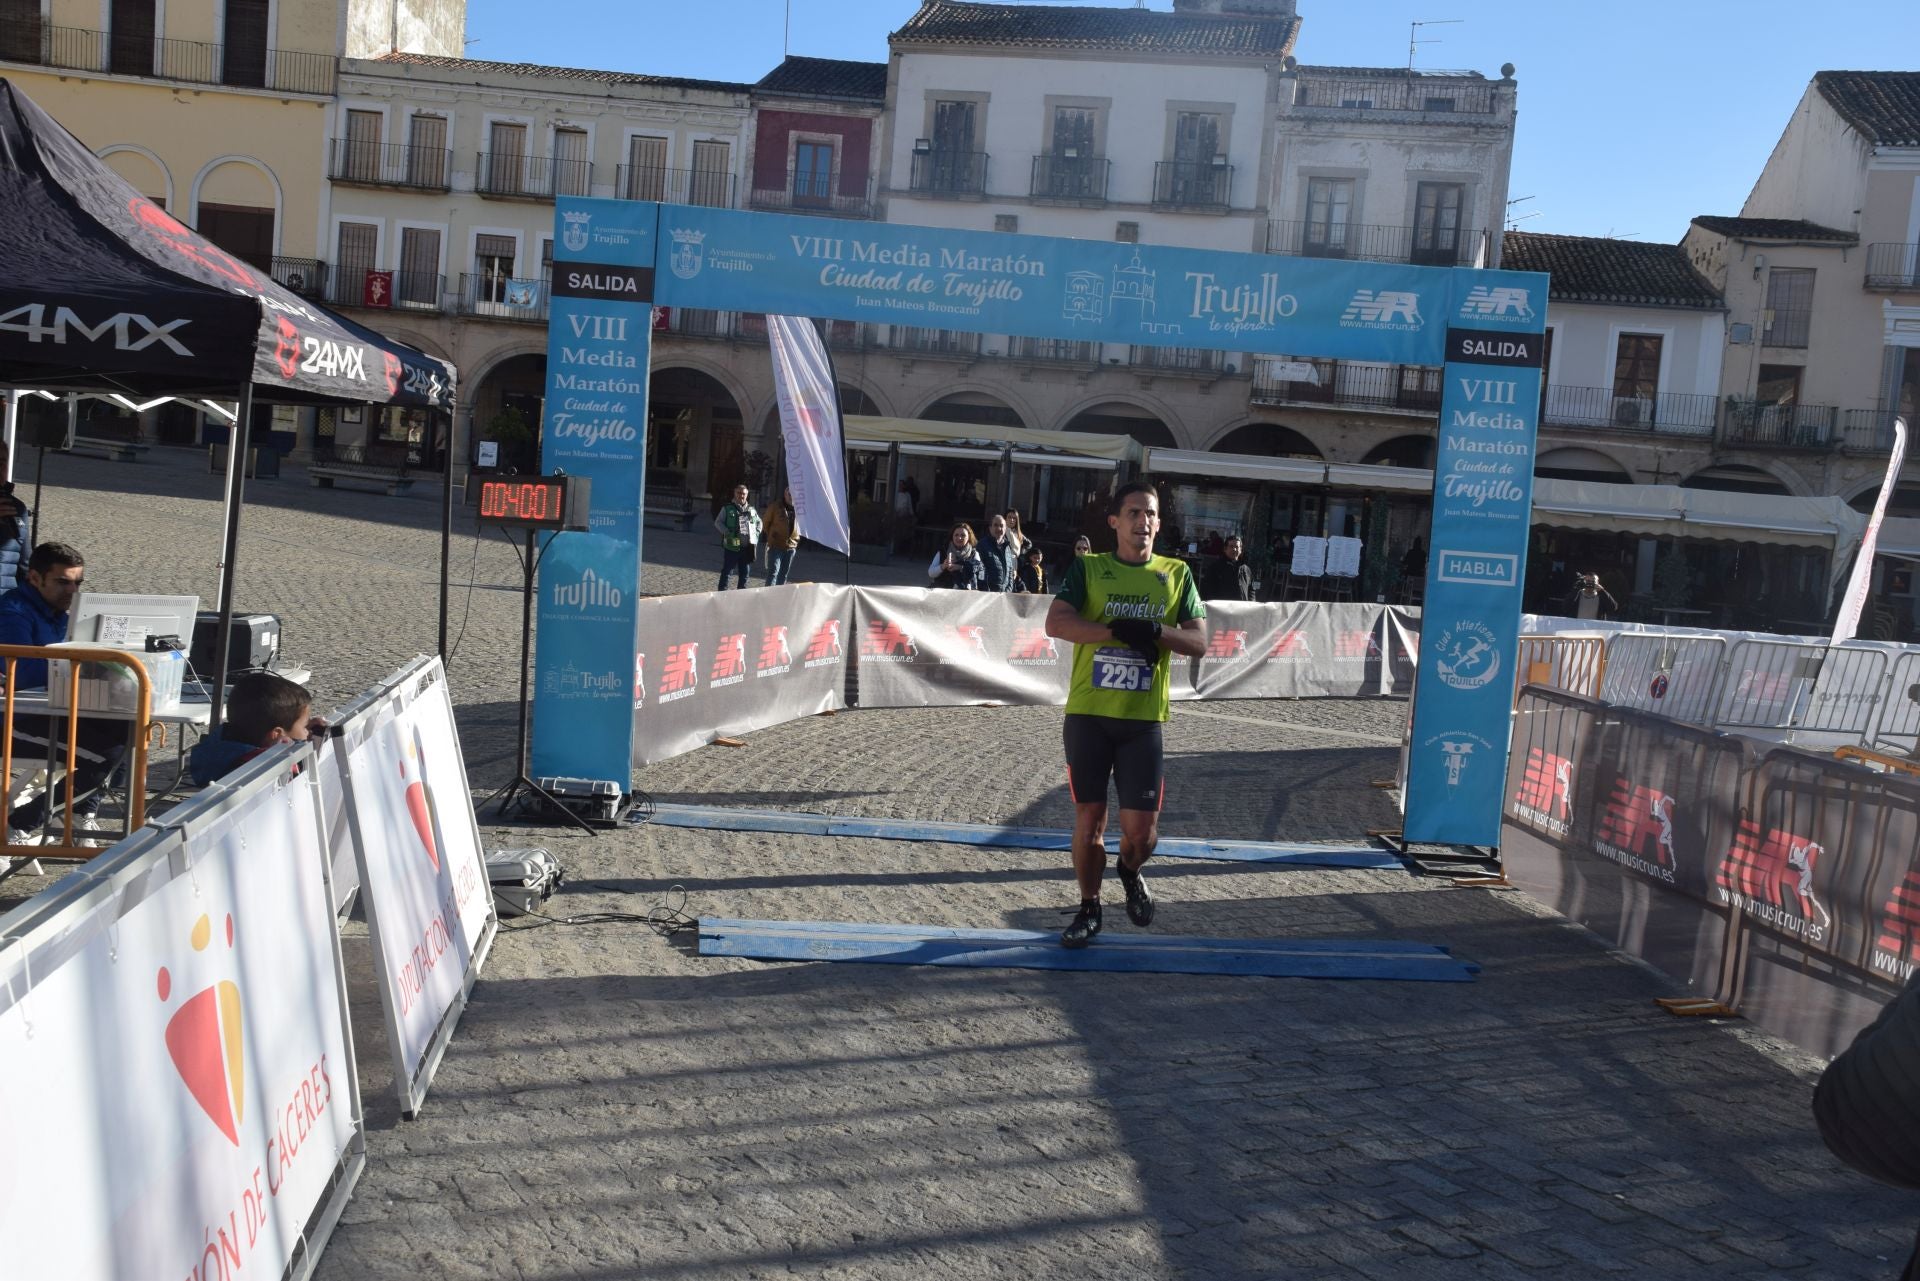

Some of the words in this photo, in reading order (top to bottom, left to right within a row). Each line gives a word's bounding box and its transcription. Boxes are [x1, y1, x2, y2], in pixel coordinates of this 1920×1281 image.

[593, 233, 630, 246] Trujillo
[710, 248, 765, 260] Ayuntamiento
[790, 234, 843, 260] VIII
[851, 240, 931, 268] Media
[939, 248, 1045, 276] Maratón
[708, 257, 753, 272] Trujillo
[568, 273, 637, 293] SALIDA
[820, 263, 902, 291] Ciudad
[906, 272, 935, 294] de
[943, 273, 1023, 306] Trujillo
[856, 295, 881, 307] Juan
[884, 297, 924, 312] Mateos
[928, 301, 979, 315] Broncano
[1185, 271, 1298, 326] Trujillo
[568, 314, 628, 341] VIII
[1209, 314, 1222, 331] te
[1339, 319, 1420, 332] www.musicrun.es
[1459, 311, 1531, 324] www.musicrun.es
[301, 336, 367, 381] 24MX
[561, 346, 637, 368] Media
[1462, 339, 1528, 358] SALIDA
[554, 373, 641, 394] Maratón
[1459, 378, 1517, 404] VIII
[564, 397, 608, 412] Ciudad
[611, 402, 626, 413] de
[1452, 410, 1525, 430] Media
[552, 413, 637, 448] Trujillo
[1446, 435, 1528, 455] Maratón
[1454, 459, 1497, 473] Ciudad
[1499, 462, 1514, 474] de
[1443, 474, 1524, 507] Trujillo
[1450, 560, 1505, 576] HABLA
[1435, 629, 1452, 652] Club
[1455, 619, 1497, 643] Atletismo
[860, 654, 914, 663] www.musicrun.es
[1008, 658, 1056, 666] www.musicrun.es
[580, 671, 622, 689] Trujillo
[1101, 664, 1139, 689] 229
[1513, 801, 1569, 836] www.musicrun.es
[1596, 840, 1675, 884] www.musicrun.es
[1718, 887, 1823, 941] www.musicrun.es
[398, 908, 453, 1017] DIPUTACIÓN
[243, 1166, 267, 1249] DE
[267, 1053, 332, 1197] CÁCERES
